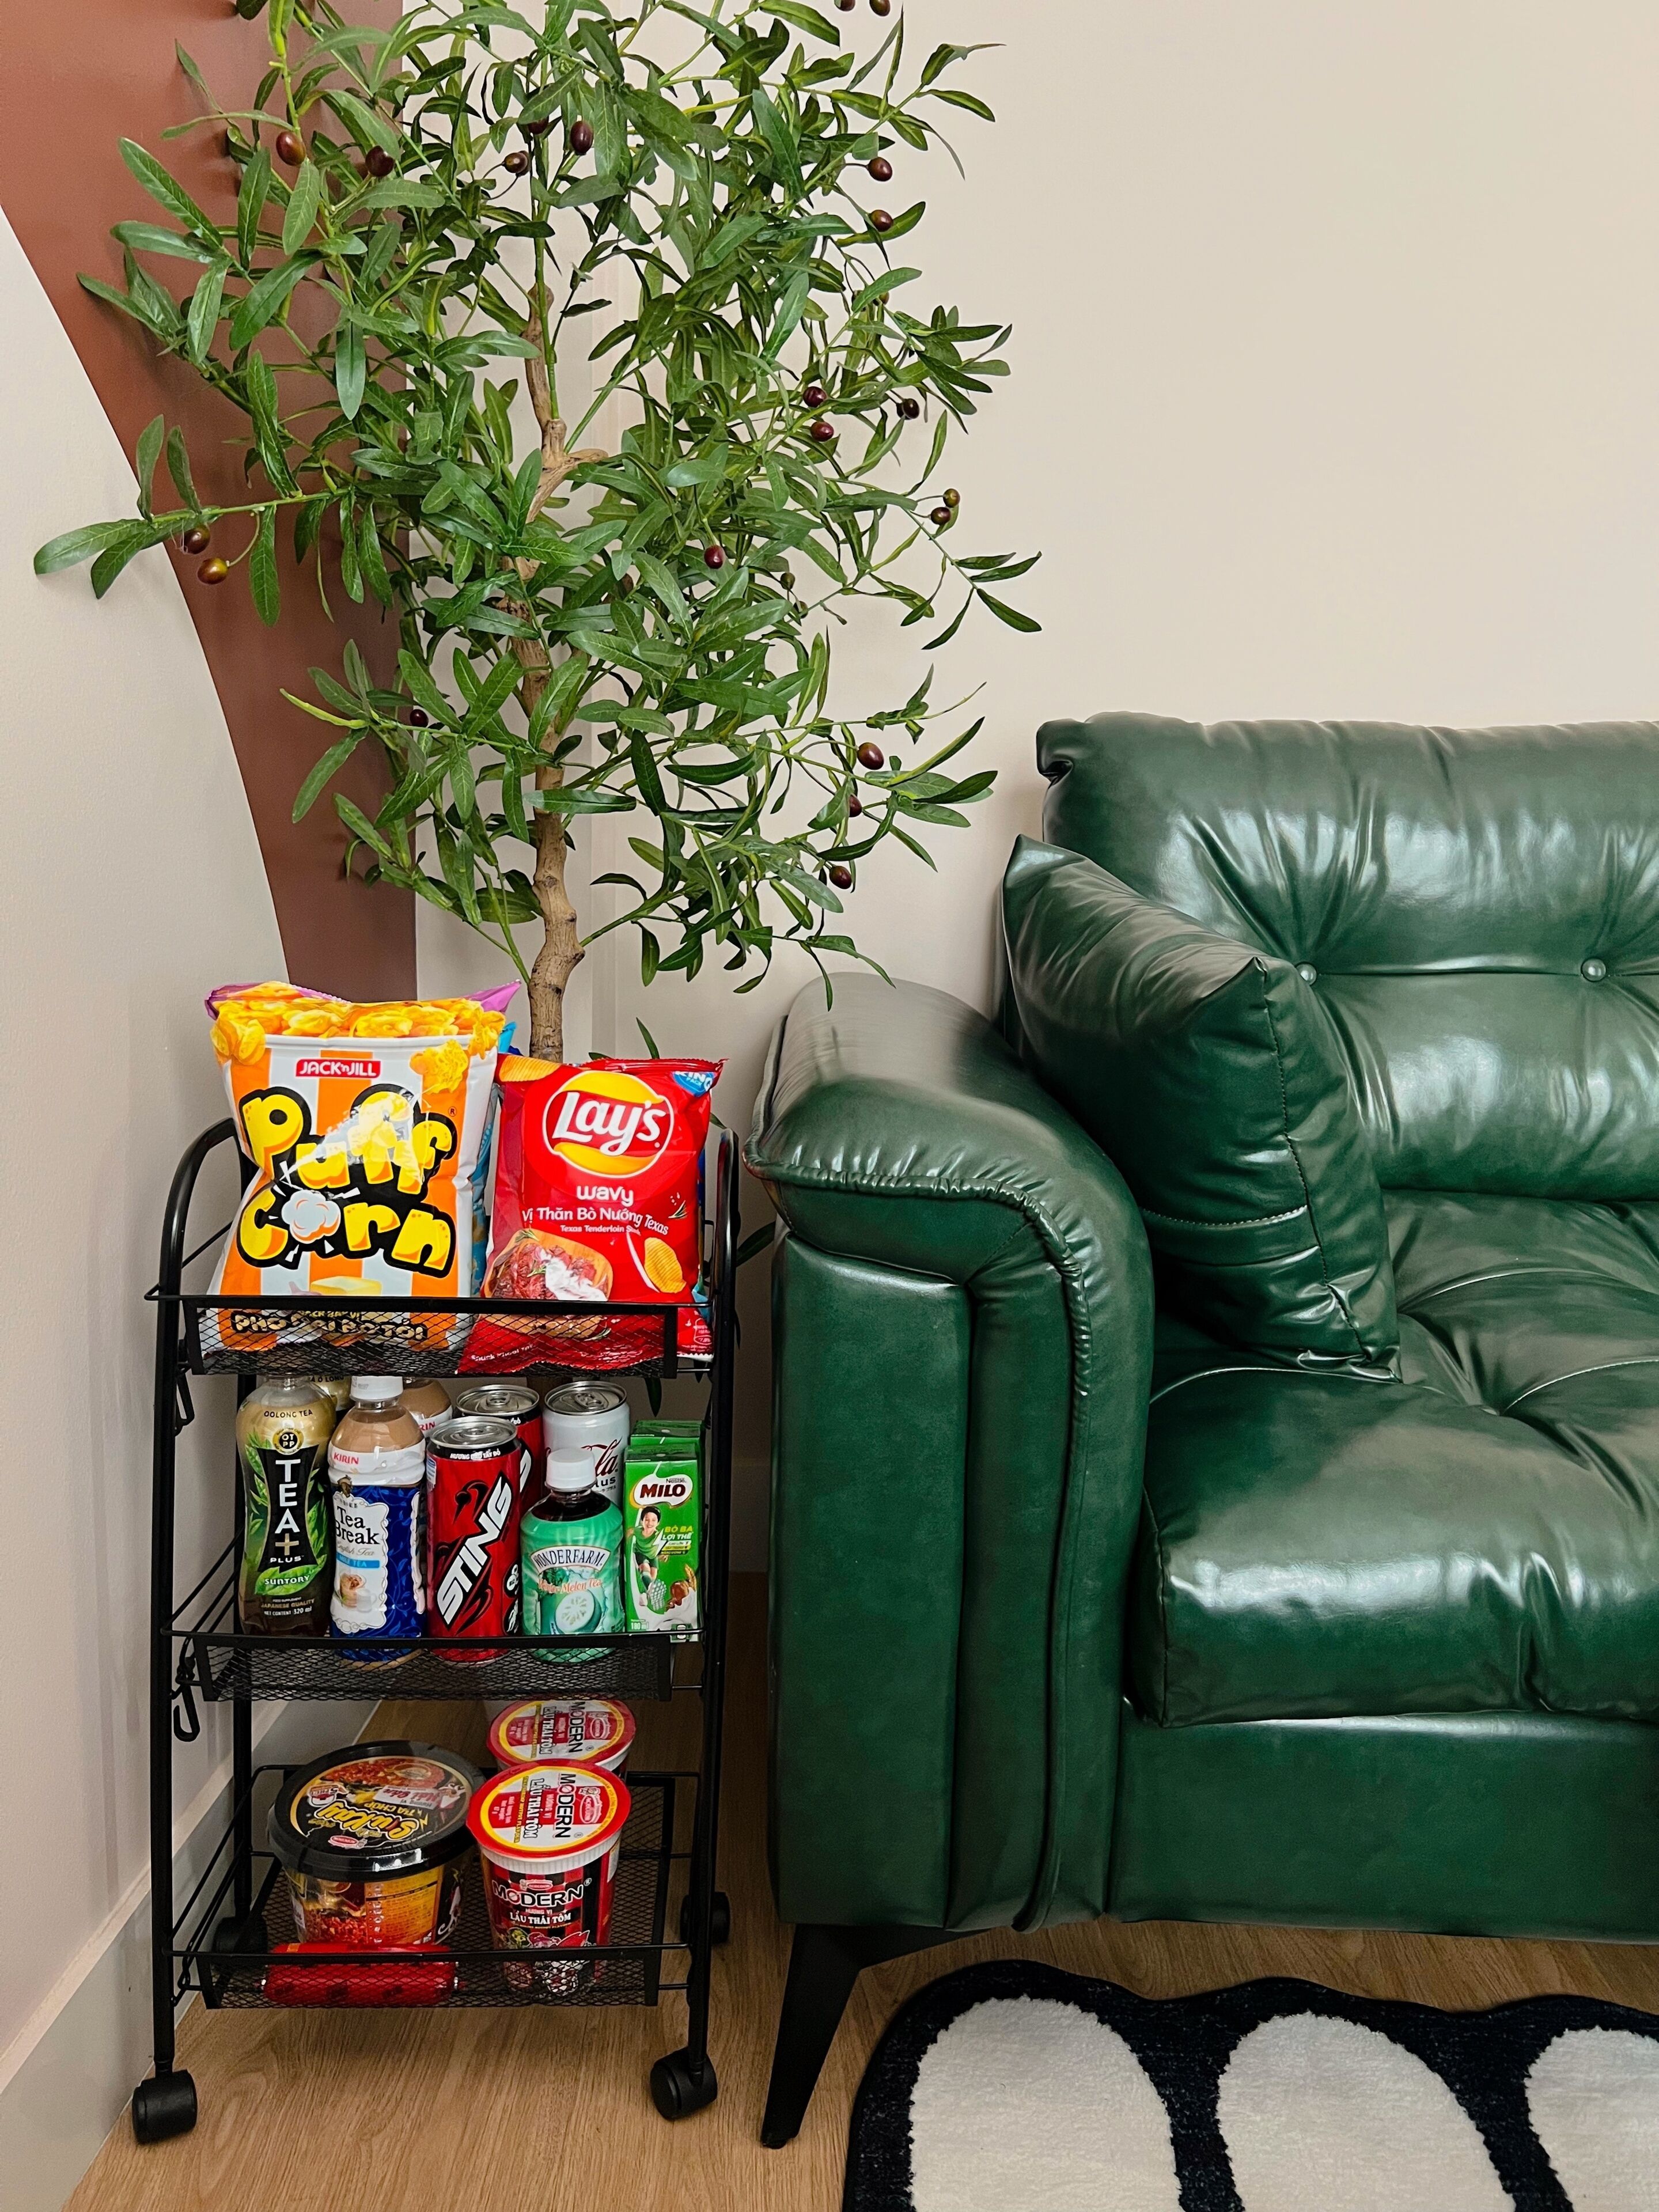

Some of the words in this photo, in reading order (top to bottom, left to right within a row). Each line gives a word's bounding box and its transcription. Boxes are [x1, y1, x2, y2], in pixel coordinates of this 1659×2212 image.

[552, 1092, 666, 1157] Lay's
[577, 1185, 634, 1207] wavy
[522, 1208, 533, 1224] Vị
[536, 1207, 573, 1221] Thăn
[577, 1207, 597, 1221] Bò
[600, 1207, 643, 1228] Nướng
[644, 1214, 669, 1236] Texas
[584, 1224, 624, 1232] Tenderloin
[299, 1409, 313, 1418] TEA
[419, 1421, 435, 1431] RIN
[334, 1452, 359, 1465] KIRIN
[595, 1476, 616, 1488] lus
[639, 1484, 686, 1498] MILO
[337, 1505, 366, 1529] Tea
[335, 1519, 381, 1544] Break
[337, 1544, 355, 1555] nglish
[356, 1547, 374, 1556] Tea
[437, 1476, 512, 1626] STING
[534, 1548, 605, 1568] WONDERFARM
[588, 1578, 602, 1588] Tea
[291, 1599, 315, 1607] QUALITY
[569, 1701, 586, 1753] MODERN
[527, 1797, 544, 1817] THÁI
[555, 1774, 576, 1838] MODERN
[523, 1816, 543, 1838] TÔM
[493, 1880, 584, 1907] MODERN
[510, 1910, 527, 1923] LẨU
[528, 1915, 550, 1925] THÁI
[551, 1912, 571, 1922] TÔM
